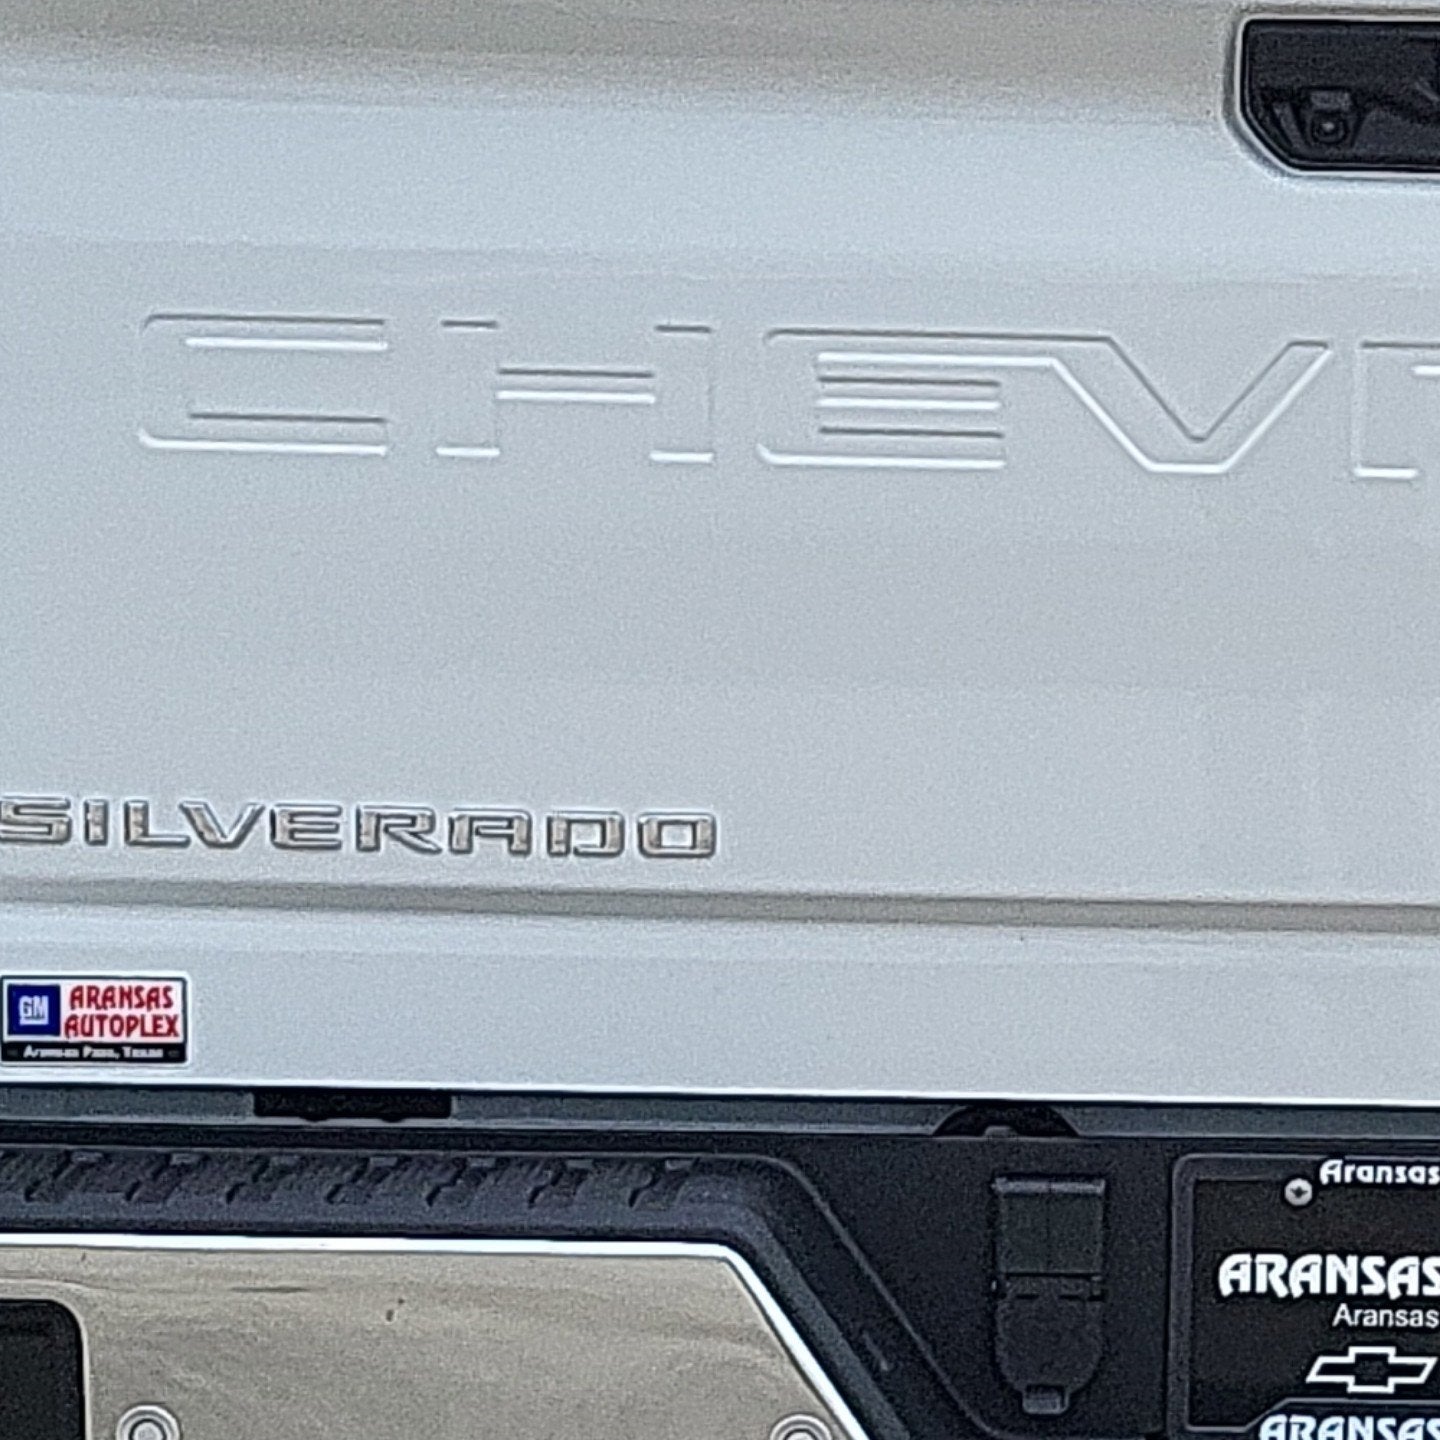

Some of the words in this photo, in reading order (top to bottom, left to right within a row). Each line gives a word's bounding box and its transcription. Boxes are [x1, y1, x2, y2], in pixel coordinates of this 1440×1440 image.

[18, 994, 50, 1026] GM
[69, 985, 174, 1011] ARANSAS
[64, 1013, 180, 1038] AUTOPLEX
[1332, 1304, 1440, 1328] Aransas
